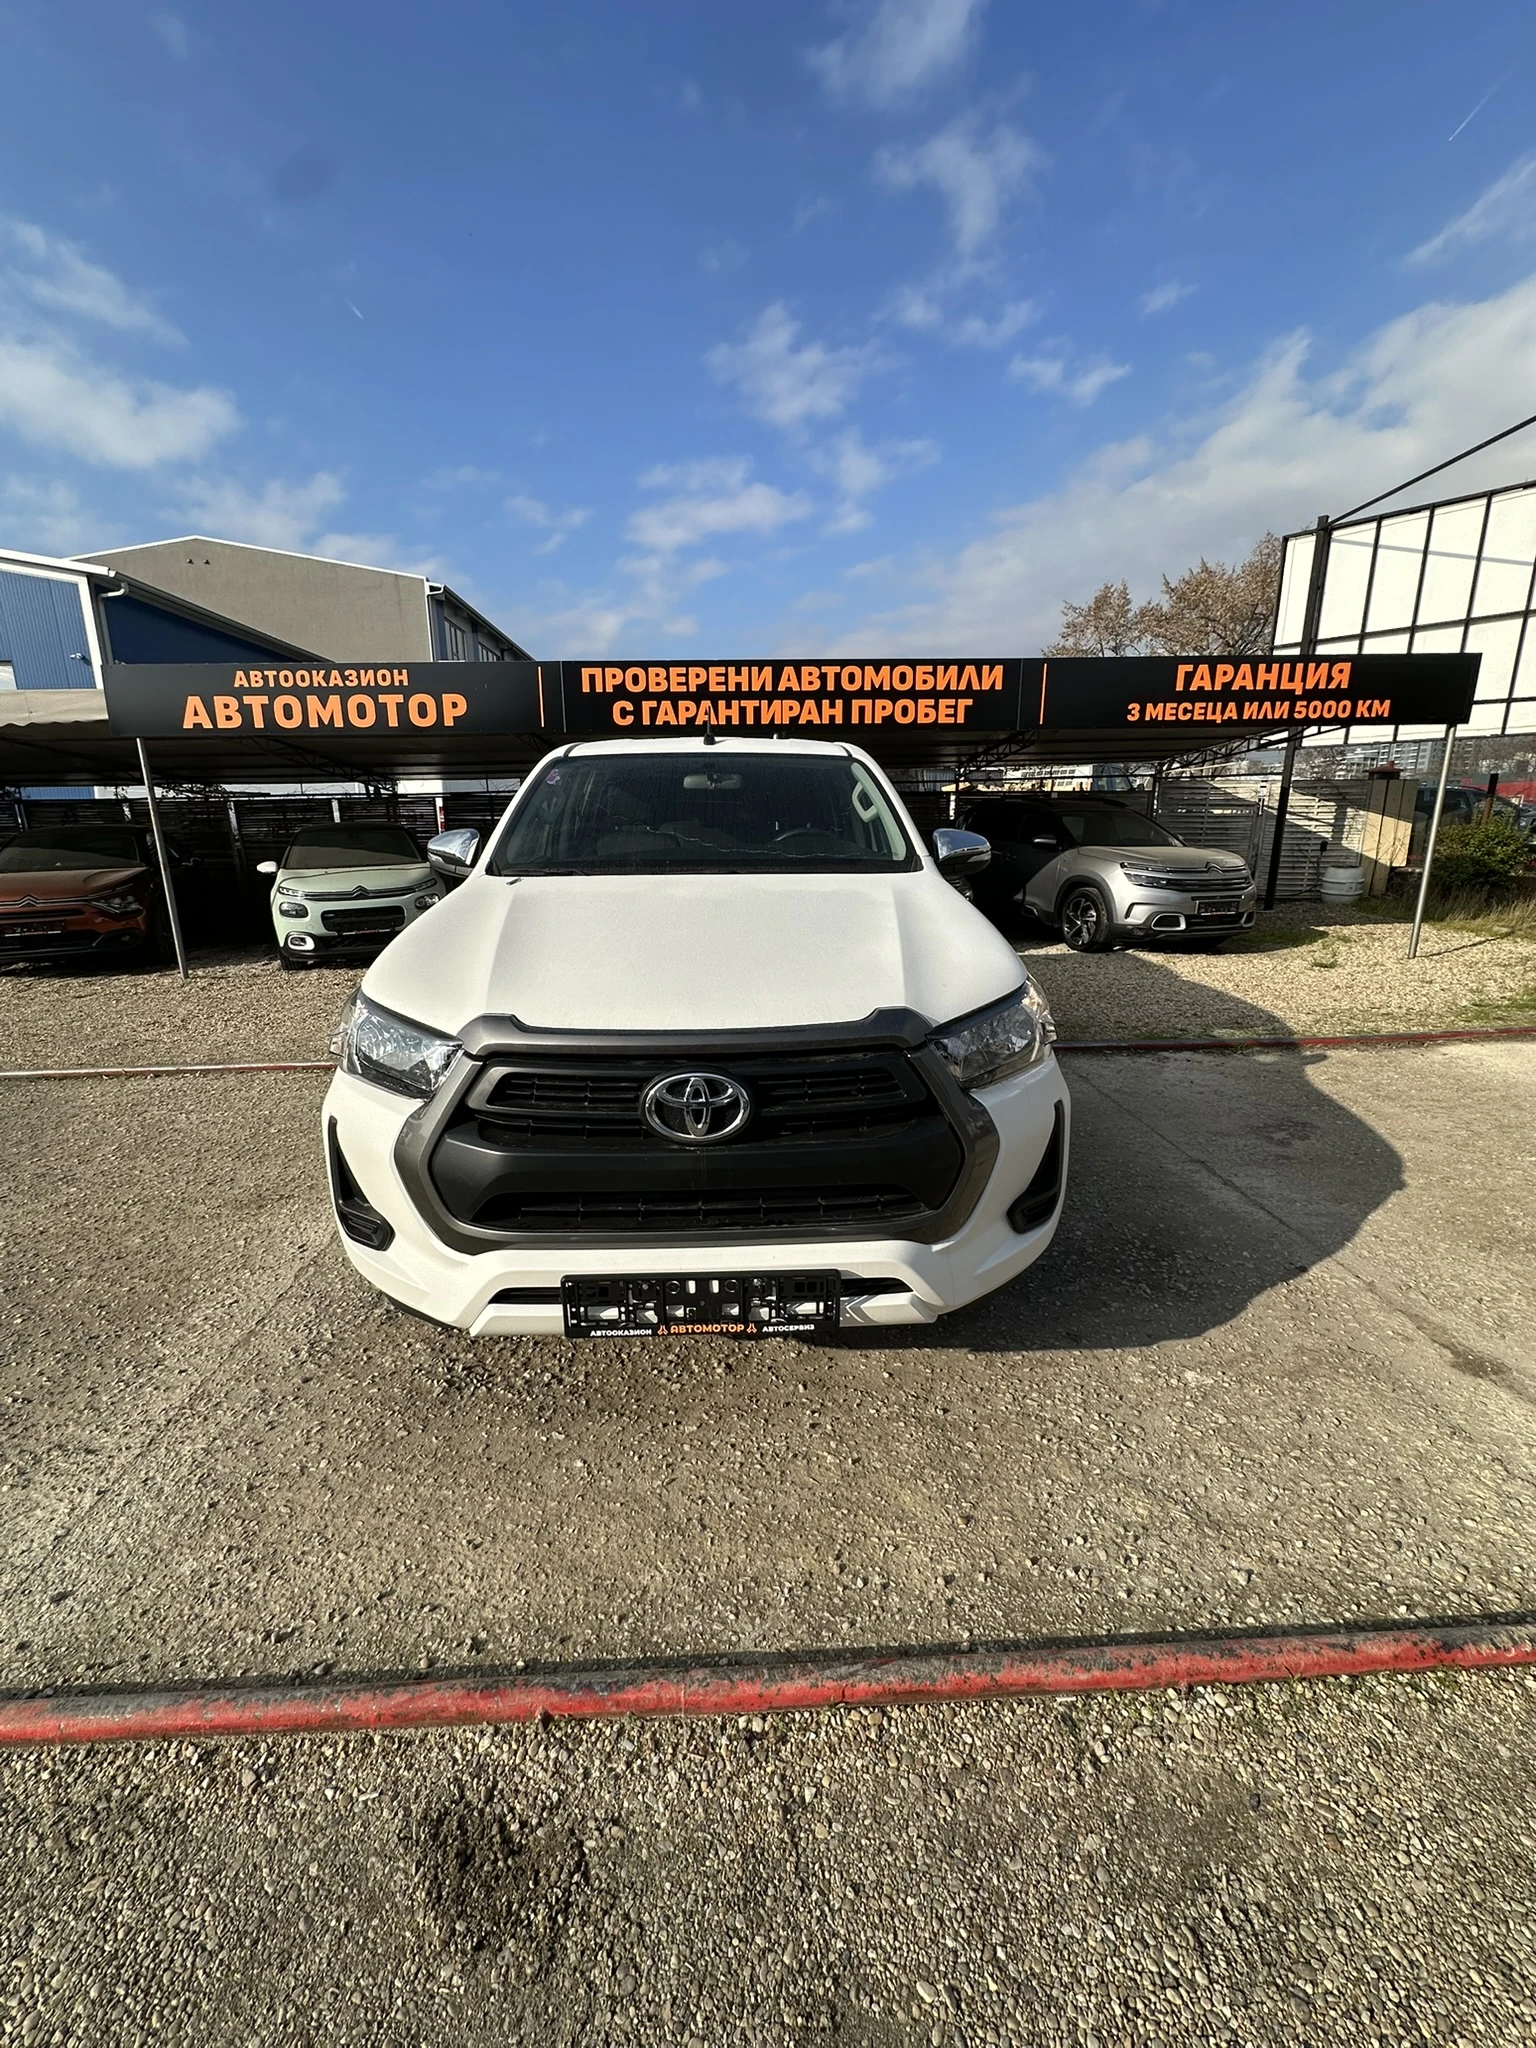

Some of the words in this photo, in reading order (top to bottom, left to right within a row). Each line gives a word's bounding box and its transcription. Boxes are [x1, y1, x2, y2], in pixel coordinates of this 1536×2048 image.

[234, 669, 408, 688] АВТООКАЗИОН
[581, 666, 772, 693] ПРОВЕРЕНИ
[777, 665, 1004, 692] АВТОМОБИЛИ
[1175, 662, 1352, 695] ГАРАНЦИЯ
[182, 693, 468, 730] АВТОМОТОР
[612, 700, 634, 726] С
[641, 699, 843, 726] ГАРАНТИРАН
[851, 698, 973, 724] ПРОБЕГ
[1126, 703, 1141, 722] 3
[1144, 701, 1238, 724] МЕСЕЦА
[1243, 701, 1290, 720] ИЛИ
[1293, 699, 1351, 719] 5000
[1355, 698, 1391, 718] КМ
[589, 1328, 653, 1337] АВТООКАЗИОН
[669, 1324, 745, 1334] АВТОМОТОР
[761, 1323, 816, 1333] АВТОСЕРВИЗ
